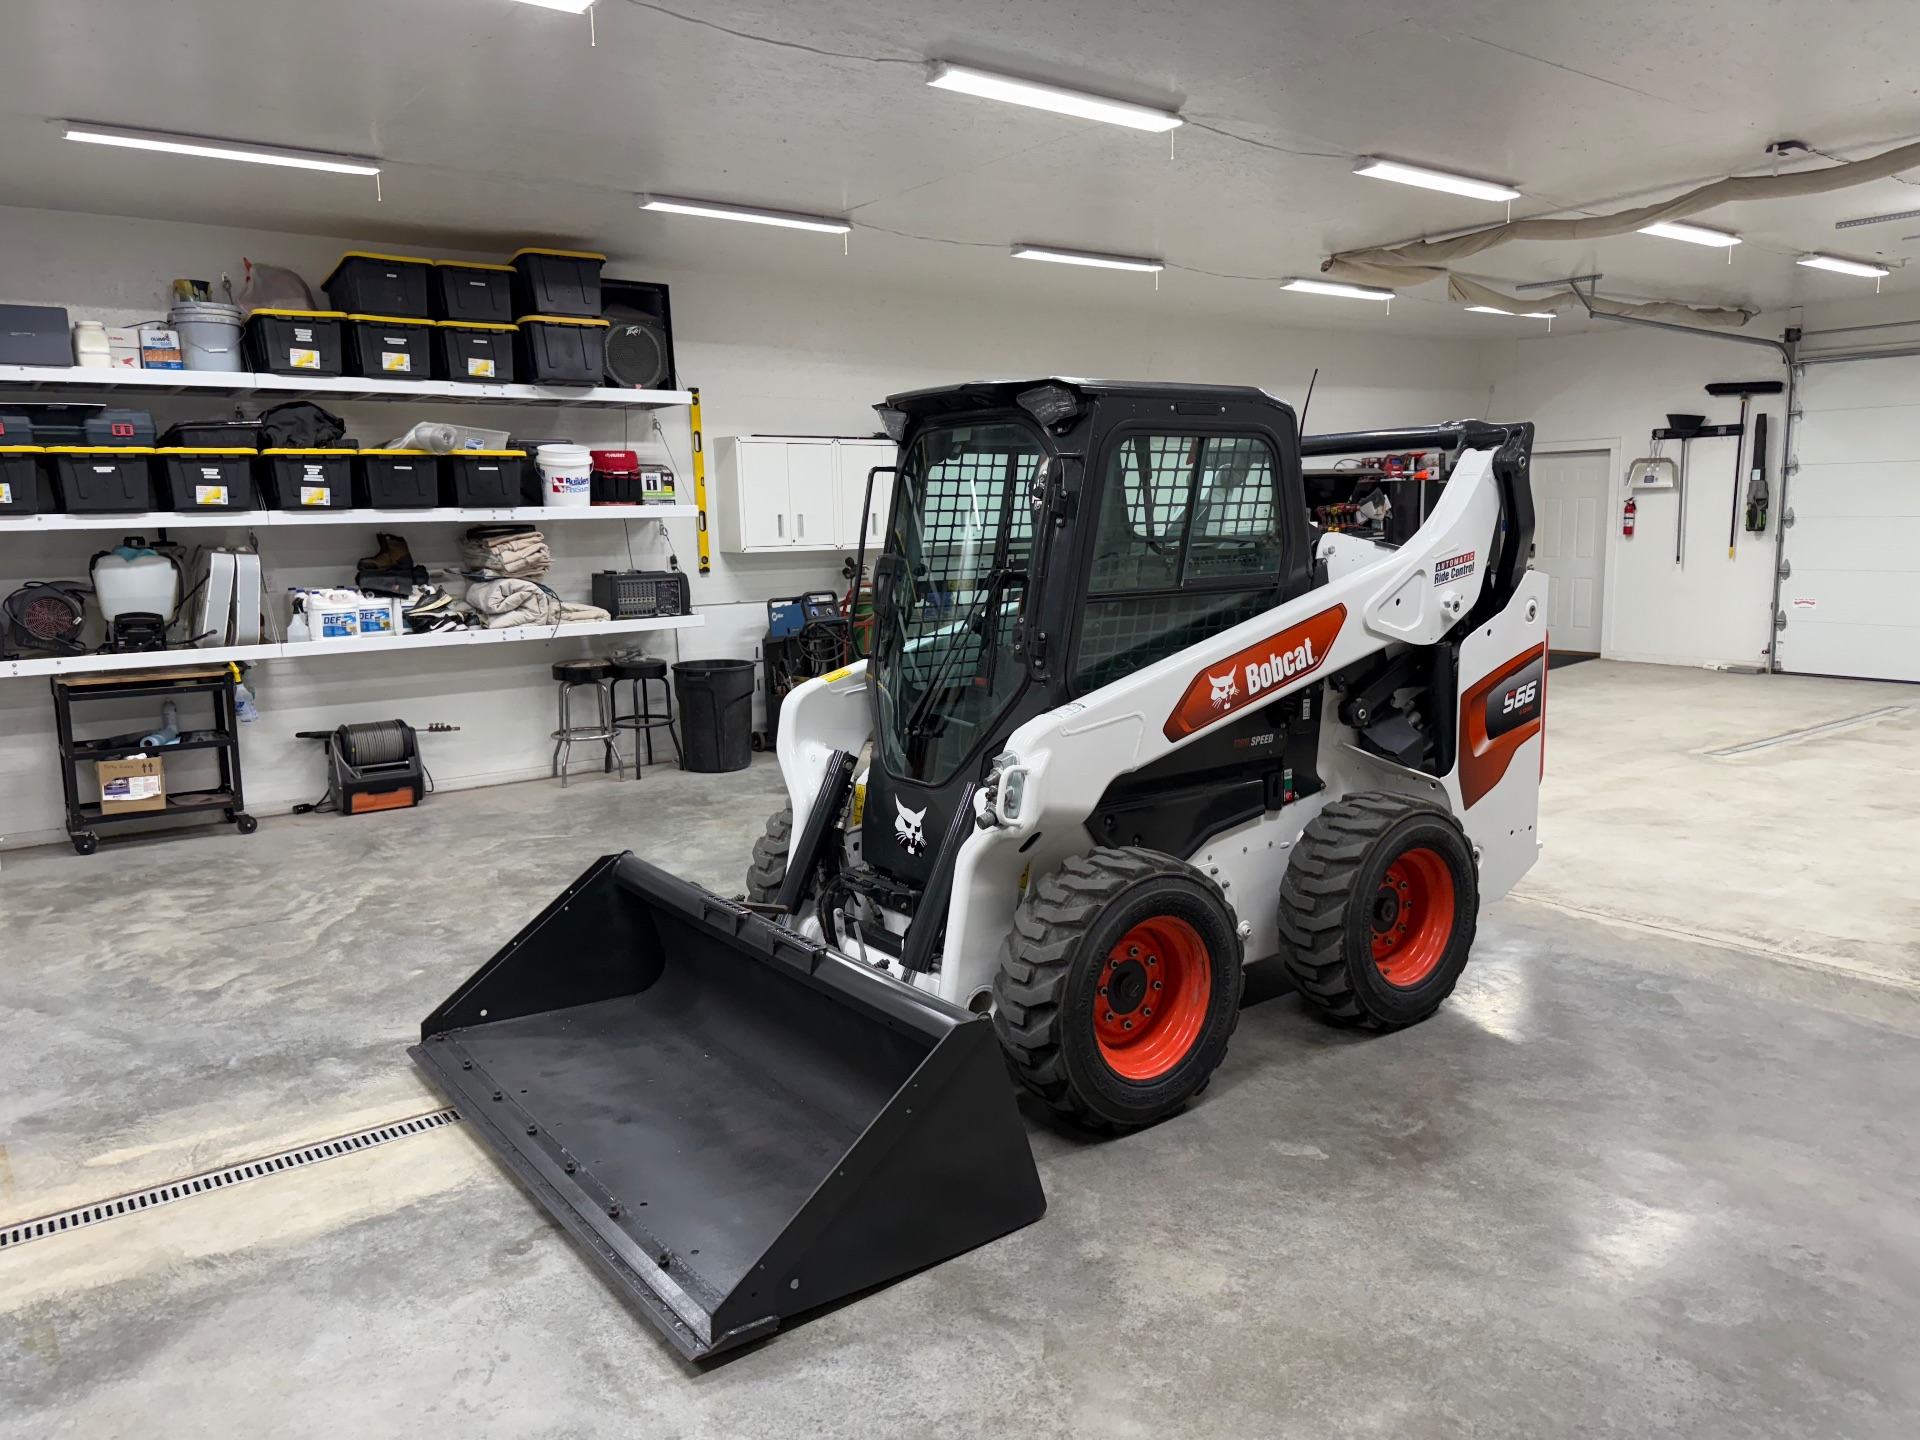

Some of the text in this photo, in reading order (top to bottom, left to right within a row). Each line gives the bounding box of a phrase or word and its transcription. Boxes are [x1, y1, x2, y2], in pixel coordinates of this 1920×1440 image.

[1436, 551, 1475, 571] AUTOMATIC
[1434, 561, 1475, 584] Ride Control
[323, 616, 342, 625] DEF
[360, 611, 375, 620] DEF
[1245, 637, 1314, 696] Bobcat
[1503, 680, 1537, 715] S66
[1250, 734, 1274, 746] SPEED
